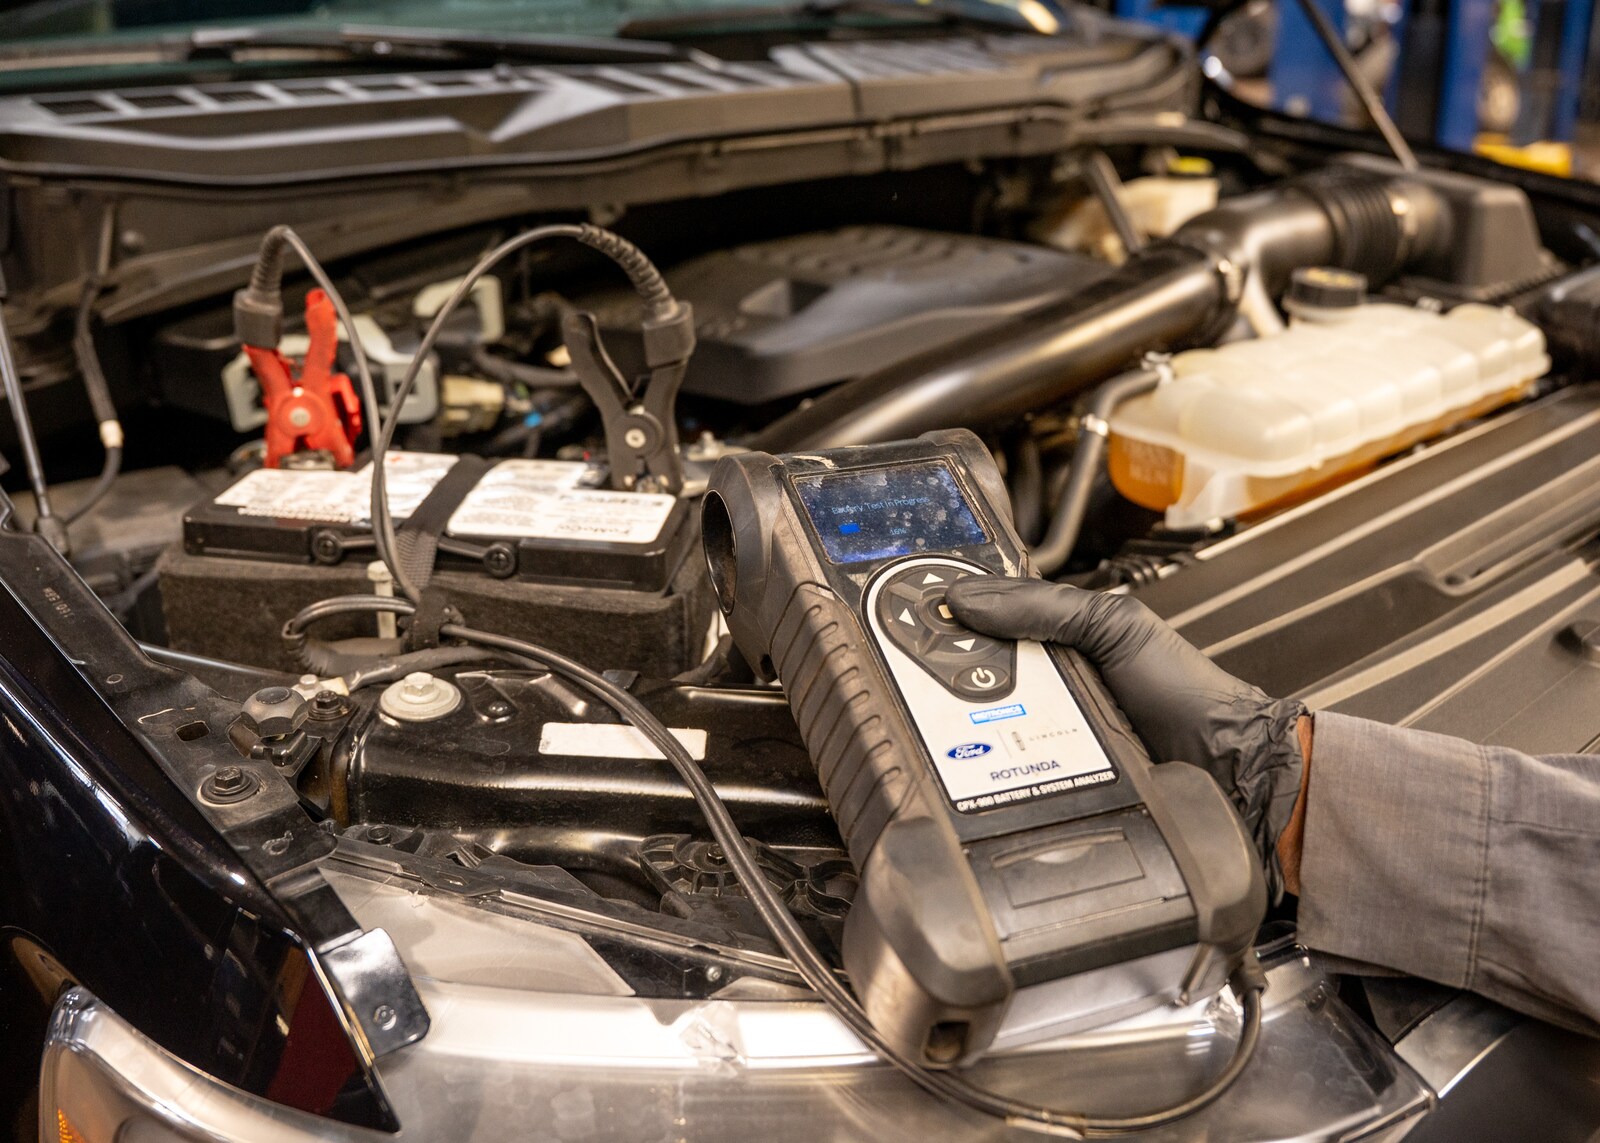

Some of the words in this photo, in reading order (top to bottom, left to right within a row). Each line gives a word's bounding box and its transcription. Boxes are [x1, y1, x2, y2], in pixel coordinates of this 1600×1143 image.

[865, 501, 885, 510] Test
[953, 743, 986, 759] Ford
[990, 760, 1061, 781] ROTUNDA
[994, 788, 1032, 804] BATTERY
[1031, 786, 1040, 797] &
[1039, 779, 1074, 795] SYSTEM
[1074, 771, 1116, 788] ANALYZER
